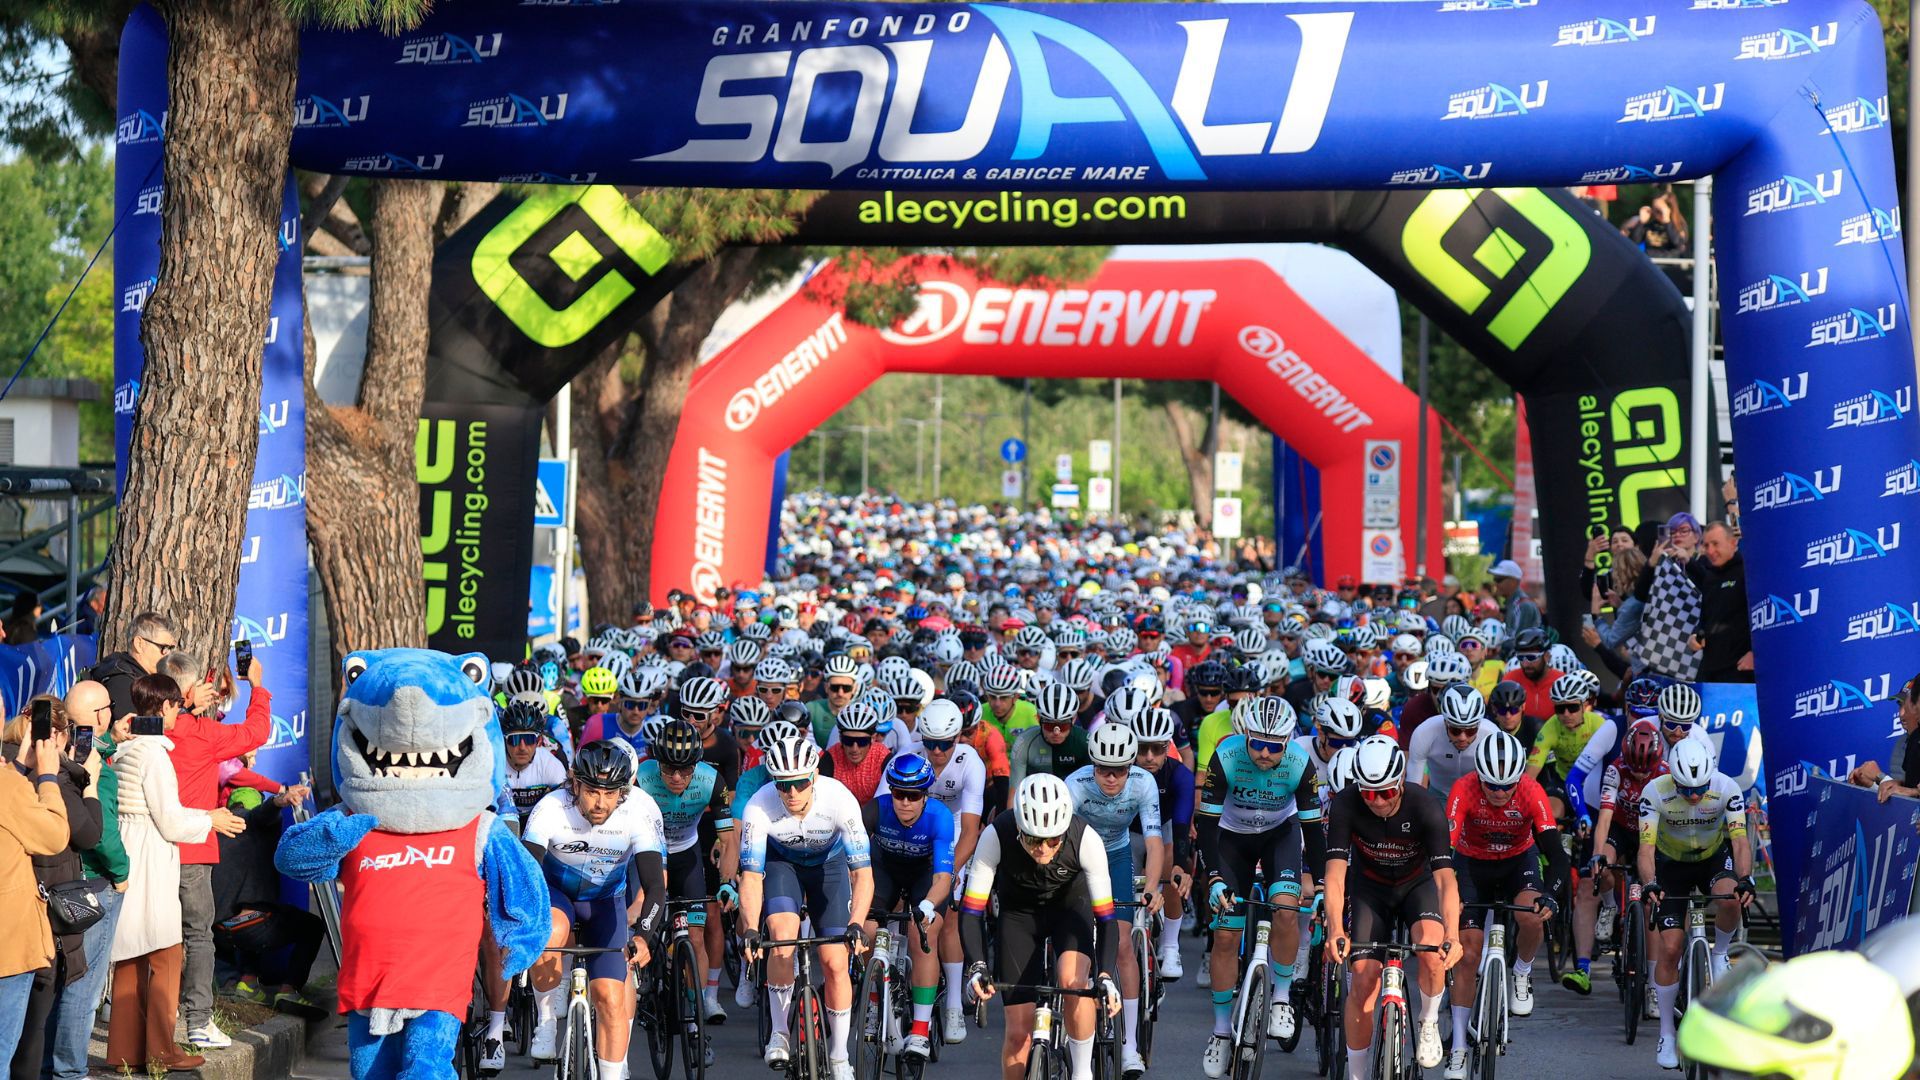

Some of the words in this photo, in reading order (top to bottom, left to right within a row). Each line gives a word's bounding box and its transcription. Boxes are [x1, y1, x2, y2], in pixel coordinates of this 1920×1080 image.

[395, 33, 502, 64] SQUALI
[712, 12, 971, 46] GRANFONDO
[1552, 15, 1657, 48] SQUALI
[1734, 22, 1839, 61] SQUALI
[293, 94, 370, 128] UALI
[461, 93, 568, 128] SQUALI
[630, 3, 1355, 180] SQUALI
[1440, 80, 1548, 121] SQUALI
[1616, 83, 1725, 123] SQUALI
[856, 167, 955, 180] CATTOLICA
[965, 168, 978, 180] &
[985, 167, 1075, 180] GABICCE
[1081, 166, 1150, 180] MARE
[1388, 162, 1492, 185] SQUALI
[1578, 161, 1682, 184] SQUALI
[1743, 169, 1842, 217] SQUALI
[858, 190, 1187, 228] alecycling.com
[1736, 267, 1828, 315] SQUALI
[963, 287, 1218, 347] ENERVIT
[1804, 303, 1896, 348] SQUALI
[754, 310, 848, 408] ENERVIT
[1266, 350, 1373, 433] ENERVIT
[1733, 371, 1808, 418] SQUALI
[1826, 386, 1911, 429] SQUALI
[1752, 465, 1842, 511] SQUALI
[1880, 459, 1920, 498] SQU
[695, 447, 727, 567] ENERVIT
[450, 421, 489, 639] alecycling.com
[1800, 521, 1900, 569] SQUALI
[1807, 531, 1847, 547] GRANFONDO
[1751, 588, 1820, 633] SQUALI
[1841, 600, 1920, 642] SQUA
[1790, 673, 1891, 719] SQUALI
[358, 844, 456, 873] PASQUALO
[1810, 818, 1897, 952] SQUALI
[1691, 913, 1704, 925] 28
[876, 936, 888, 948] 56
[1492, 934, 1504, 946] 15
